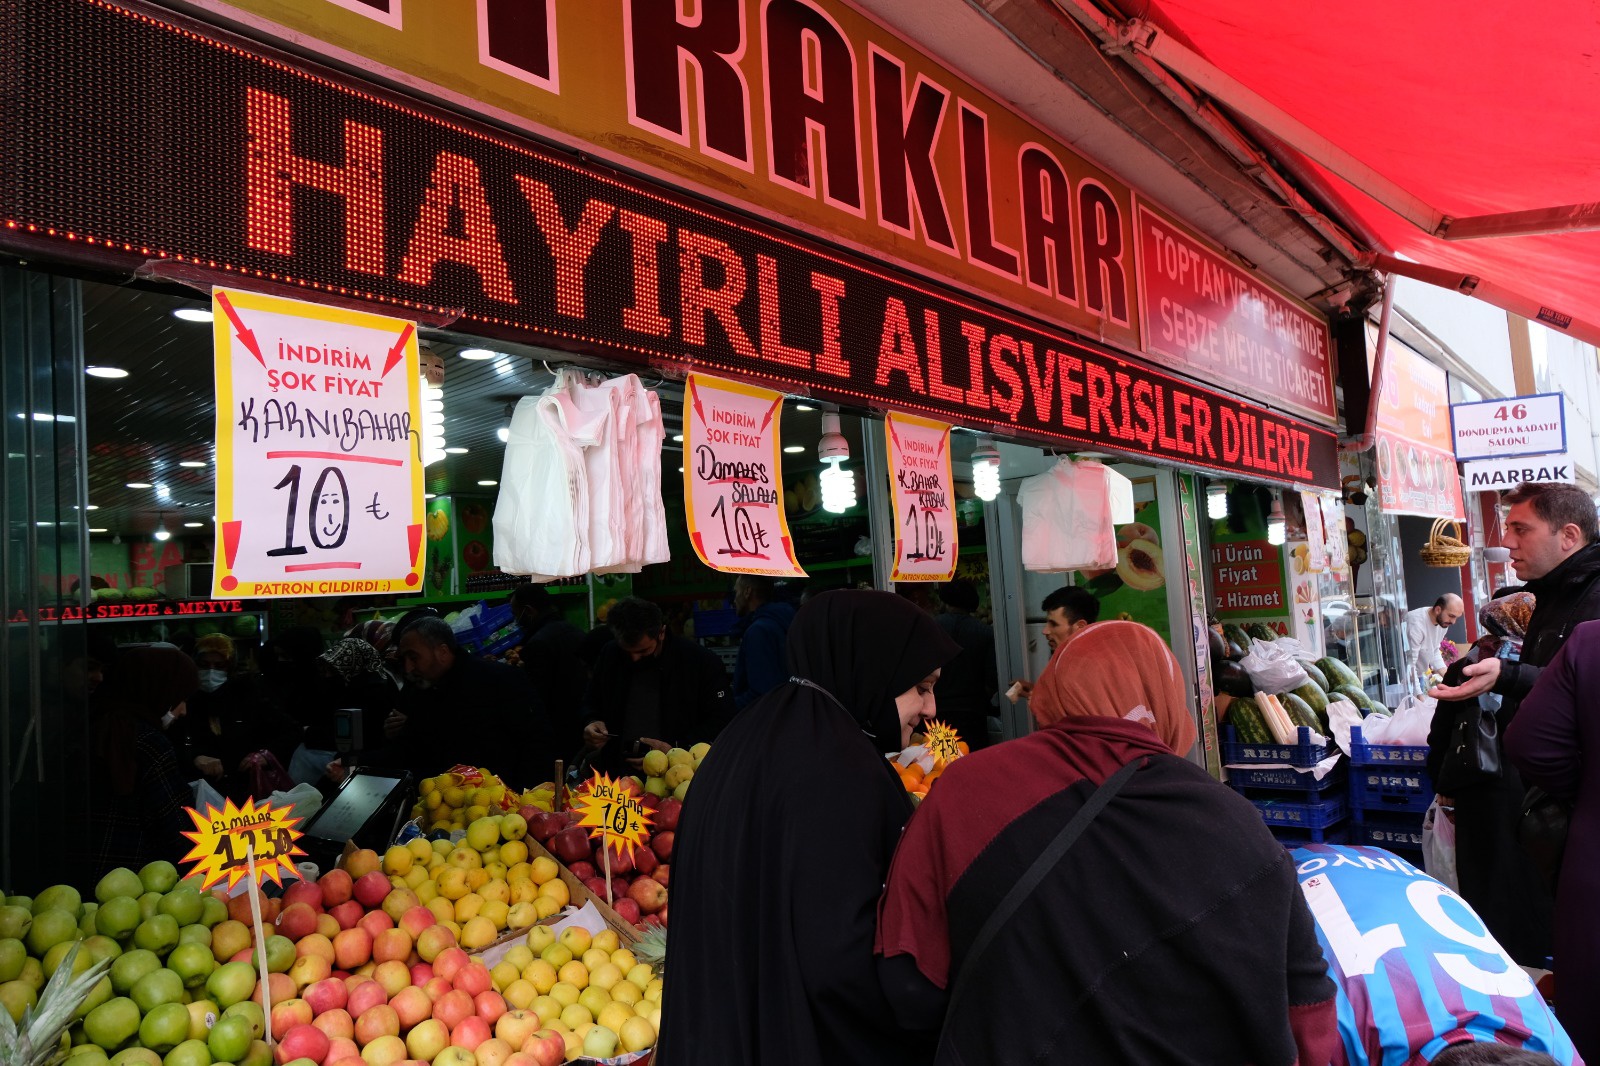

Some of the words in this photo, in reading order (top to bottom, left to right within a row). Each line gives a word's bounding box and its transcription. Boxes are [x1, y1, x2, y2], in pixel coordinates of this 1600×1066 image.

[328, 0, 1131, 329] RAKLAR
[247, 86, 851, 378] HAYIRLI
[1151, 225, 1226, 308] TOPTAN
[1228, 272, 1249, 319] VE
[1251, 285, 1325, 361] PERAKENDE
[278, 337, 372, 371] İNDİRİM
[1160, 297, 1221, 363] SEBZE
[1223, 326, 1274, 385] MEYVE
[1274, 349, 1328, 407] TİCARETİ
[267, 369, 317, 393] ŞOK
[324, 372, 384, 399] FİYAT
[712, 405, 757, 429] İNDİRİM
[1493, 403, 1528, 421] 46
[238, 397, 423, 463] KARNIBAHAR
[706, 428, 731, 445] ŞOK
[733, 430, 762, 449] FİYAT
[1458, 425, 1515, 438] DONDURMA
[1516, 421, 1560, 433] KADAYIF
[904, 436, 935, 455] İNDİRİM
[1488, 436, 1530, 447] SALONU
[902, 454, 919, 469] ŞOK
[919, 457, 939, 471] FİYAT
[1471, 465, 1570, 486] MARBAK
[266, 464, 350, 557] 10
[1225, 544, 1263, 564] Ürün
[1218, 566, 1258, 586] Fiyat
[253, 581, 314, 596] PATRON
[1227, 589, 1280, 608] Hizmet
[97, 602, 160, 619] SEBZE
[163, 606, 174, 615] &
[178, 600, 243, 615] MEYVE
[592, 784, 614, 799] DEV
[616, 793, 644, 817] ELMA
[1258, 809, 1302, 822] REi
[211, 812, 276, 835] ELMALAR
[596, 802, 628, 835] 10
